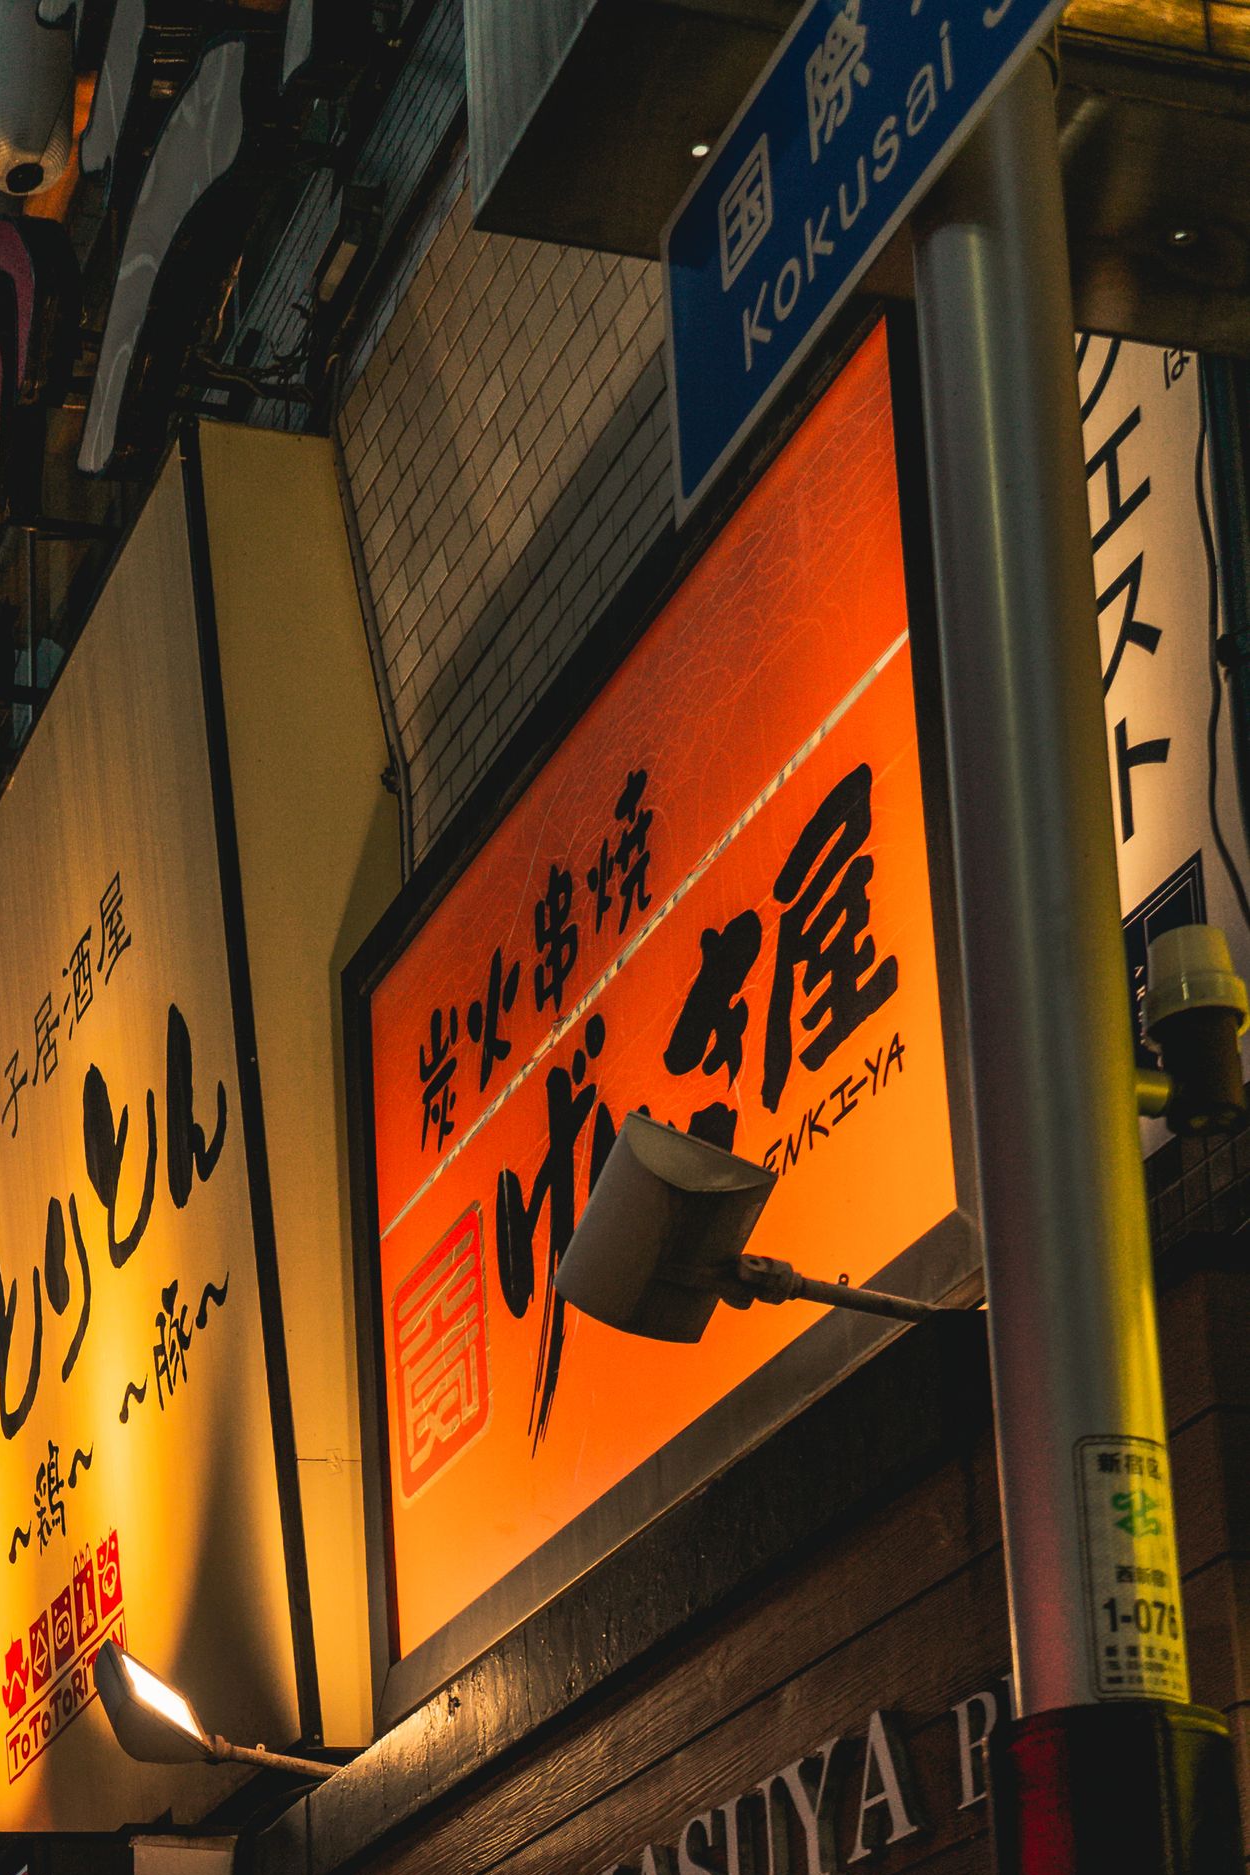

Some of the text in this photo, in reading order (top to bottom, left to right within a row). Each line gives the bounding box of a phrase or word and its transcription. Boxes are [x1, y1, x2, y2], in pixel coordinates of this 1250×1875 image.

[716, 0, 922, 292] 国際
[743, 20, 955, 372] Kokusai
[418, 769, 653, 1153] 炭火串焼
[760, 1030, 906, 1179] ENKI-YA
